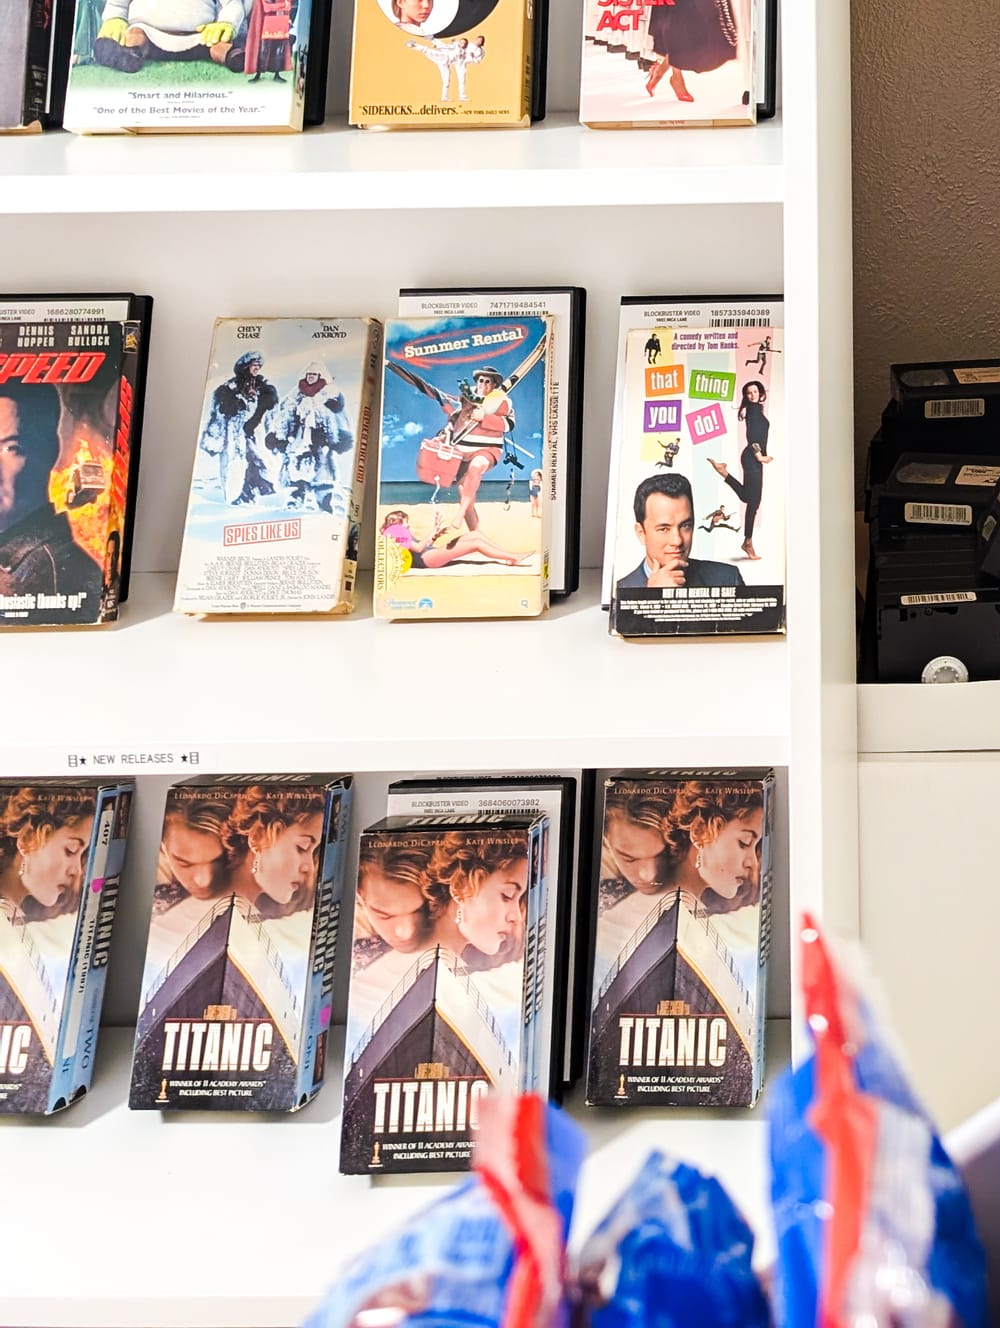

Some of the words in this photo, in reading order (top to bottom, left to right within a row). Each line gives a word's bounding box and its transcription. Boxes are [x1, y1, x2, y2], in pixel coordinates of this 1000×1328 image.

[596, 9, 645, 32] ACT
[163, 91, 181, 99] and
[131, 106, 146, 114] the
[149, 106, 170, 114] Best
[173, 106, 205, 114] Movies
[220, 105, 235, 113] the
[19, 325, 55, 336] DENNIS
[70, 325, 110, 335] SANDRA
[237, 325, 263, 333] CHEVY
[311, 331, 347, 339] AYKROYD
[17, 336, 55, 347] HOPPER
[67, 335, 110, 346] BULLOCK
[680, 332, 701, 341] comedy
[704, 332, 726, 340] written
[727, 331, 738, 339] and
[404, 338, 469, 358] Summer
[472, 327, 523, 347] Rental
[672, 342, 696, 351] directed
[707, 342, 719, 350] Tom
[650, 369, 679, 391] that
[695, 373, 730, 398] thing
[552, 381, 560, 419] CASSETTE
[648, 405, 678, 429] you
[693, 409, 721, 437] do!
[551, 421, 559, 436] VHS
[550, 469, 558, 501] SUMMER
[226, 527, 258, 544] SPIES
[260, 524, 282, 540] LIKE
[284, 522, 299, 538] US
[377, 536, 385, 591] COLLECTORS
[37, 594, 67, 609] thumbs
[93, 754, 116, 765] NEW
[121, 753, 175, 764] RELEASES
[174, 792, 212, 800] LEONARDO
[266, 792, 284, 800] KATE
[705, 787, 722, 795] KATE
[38, 793, 56, 802] KATE
[411, 800, 450, 808] BLOCKBUSTER
[406, 814, 504, 826] TITANIC
[101, 820, 111, 847] 407
[368, 840, 410, 849] LEONARDO
[466, 837, 485, 846] KATE
[487, 836, 520, 846] WINSLET
[92, 874, 120, 968] TITANIC
[83, 919, 96, 960] TITANIC
[81, 1025, 95, 1070] TWO
[162, 1022, 274, 1072] TITANIC
[618, 1017, 728, 1067] TITANIC
[169, 1080, 192, 1088] WINNER
[637, 1085, 671, 1093] INCLUDING
[178, 1089, 213, 1097] INCLUDING
[213, 1089, 227, 1097] BEST
[228, 1089, 254, 1097] PICTURE
[382, 1142, 407, 1151] WINNER
[424, 1142, 455, 1150] ACADEMY
[393, 1152, 428, 1160] INCLUDING
[429, 1151, 444, 1159] BEST
[445, 1151, 471, 1159] PICTURE
